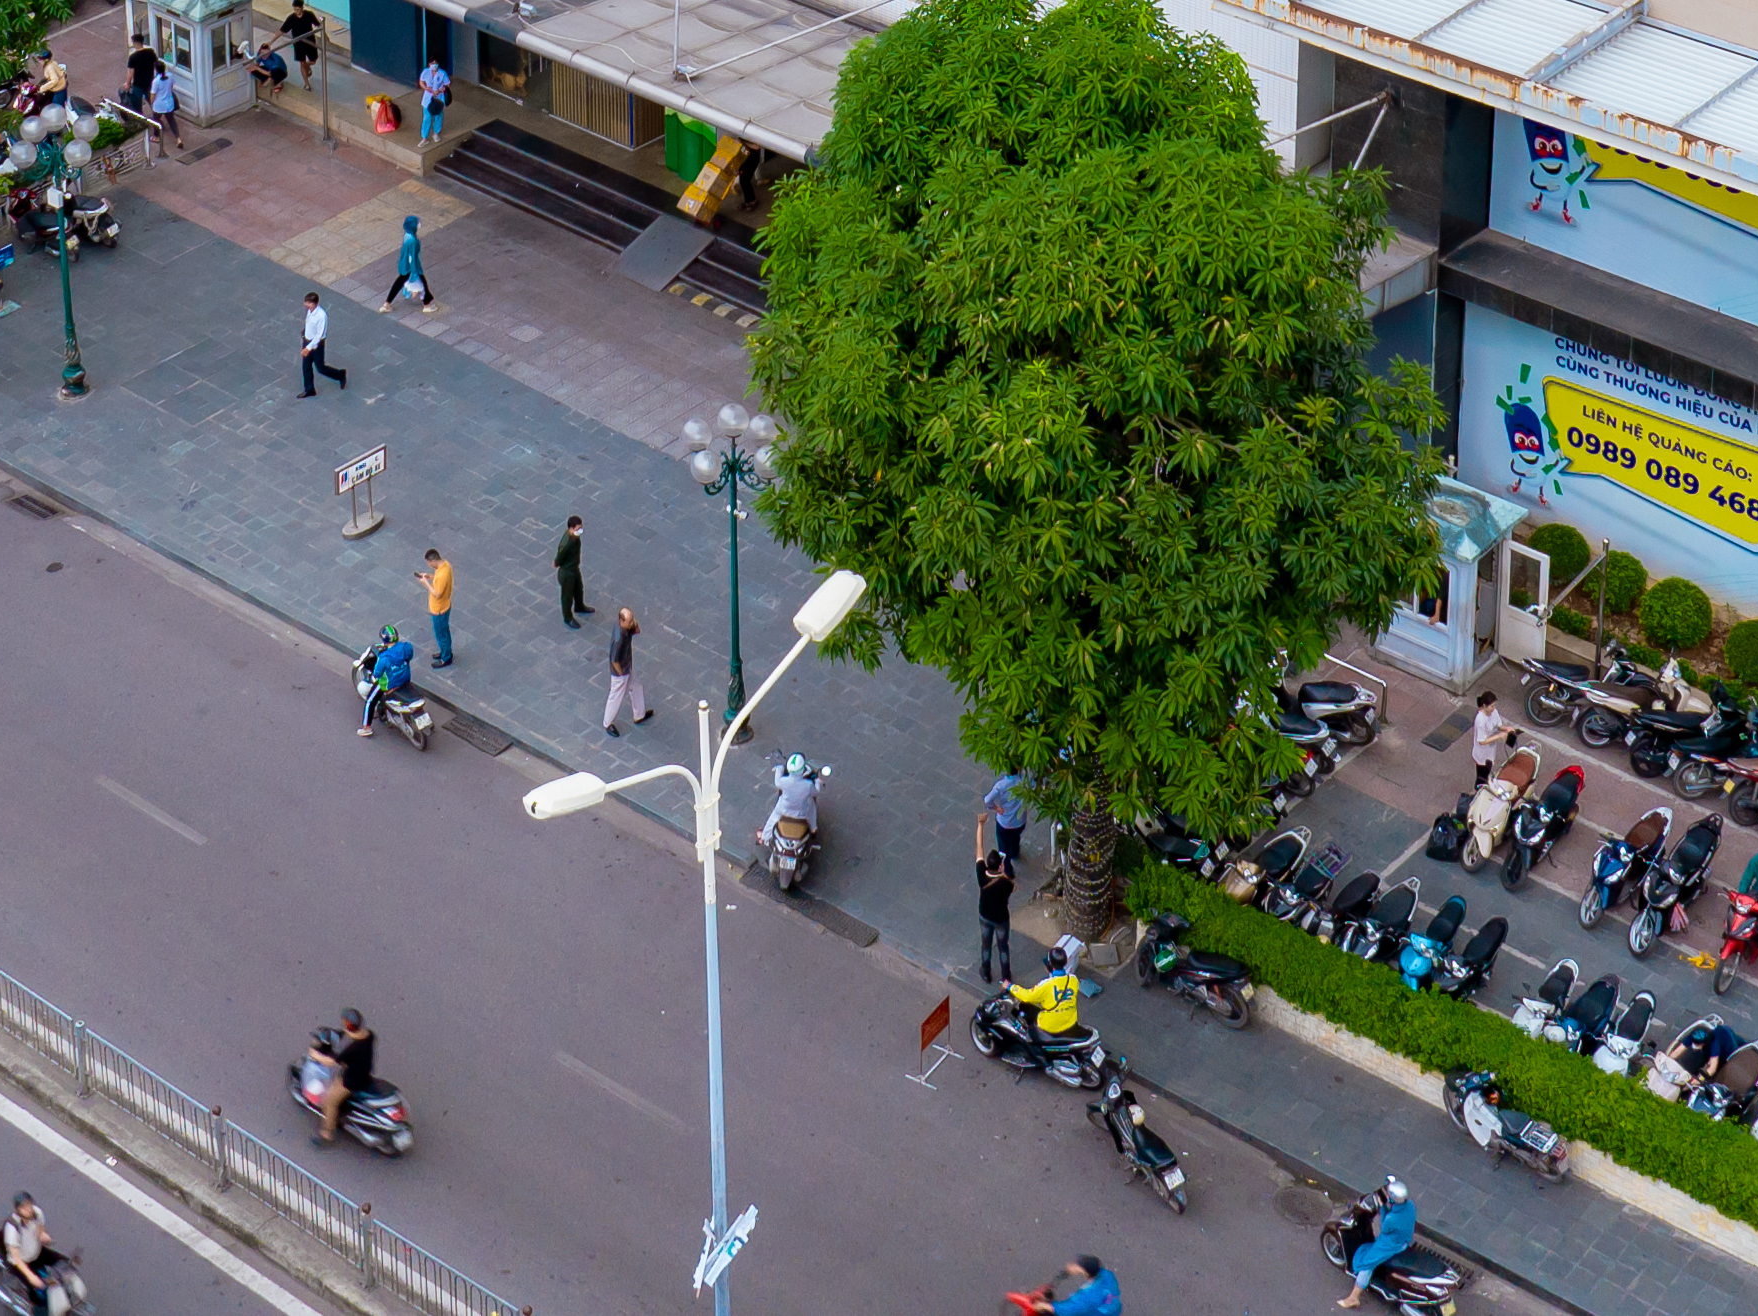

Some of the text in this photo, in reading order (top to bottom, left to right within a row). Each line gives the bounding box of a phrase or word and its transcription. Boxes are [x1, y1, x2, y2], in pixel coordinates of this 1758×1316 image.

[1555, 355, 1599, 380] CÙNG
[1603, 369, 1671, 404] THƯƠNG
[1675, 394, 1714, 420] HIỆU
[1718, 408, 1752, 434] CỦA
[1567, 426, 1637, 470] 0989
[1645, 458, 1700, 495] 089
[1582, 404, 1753, 483] LIÊN HỆ QUẢNG CÁO:
